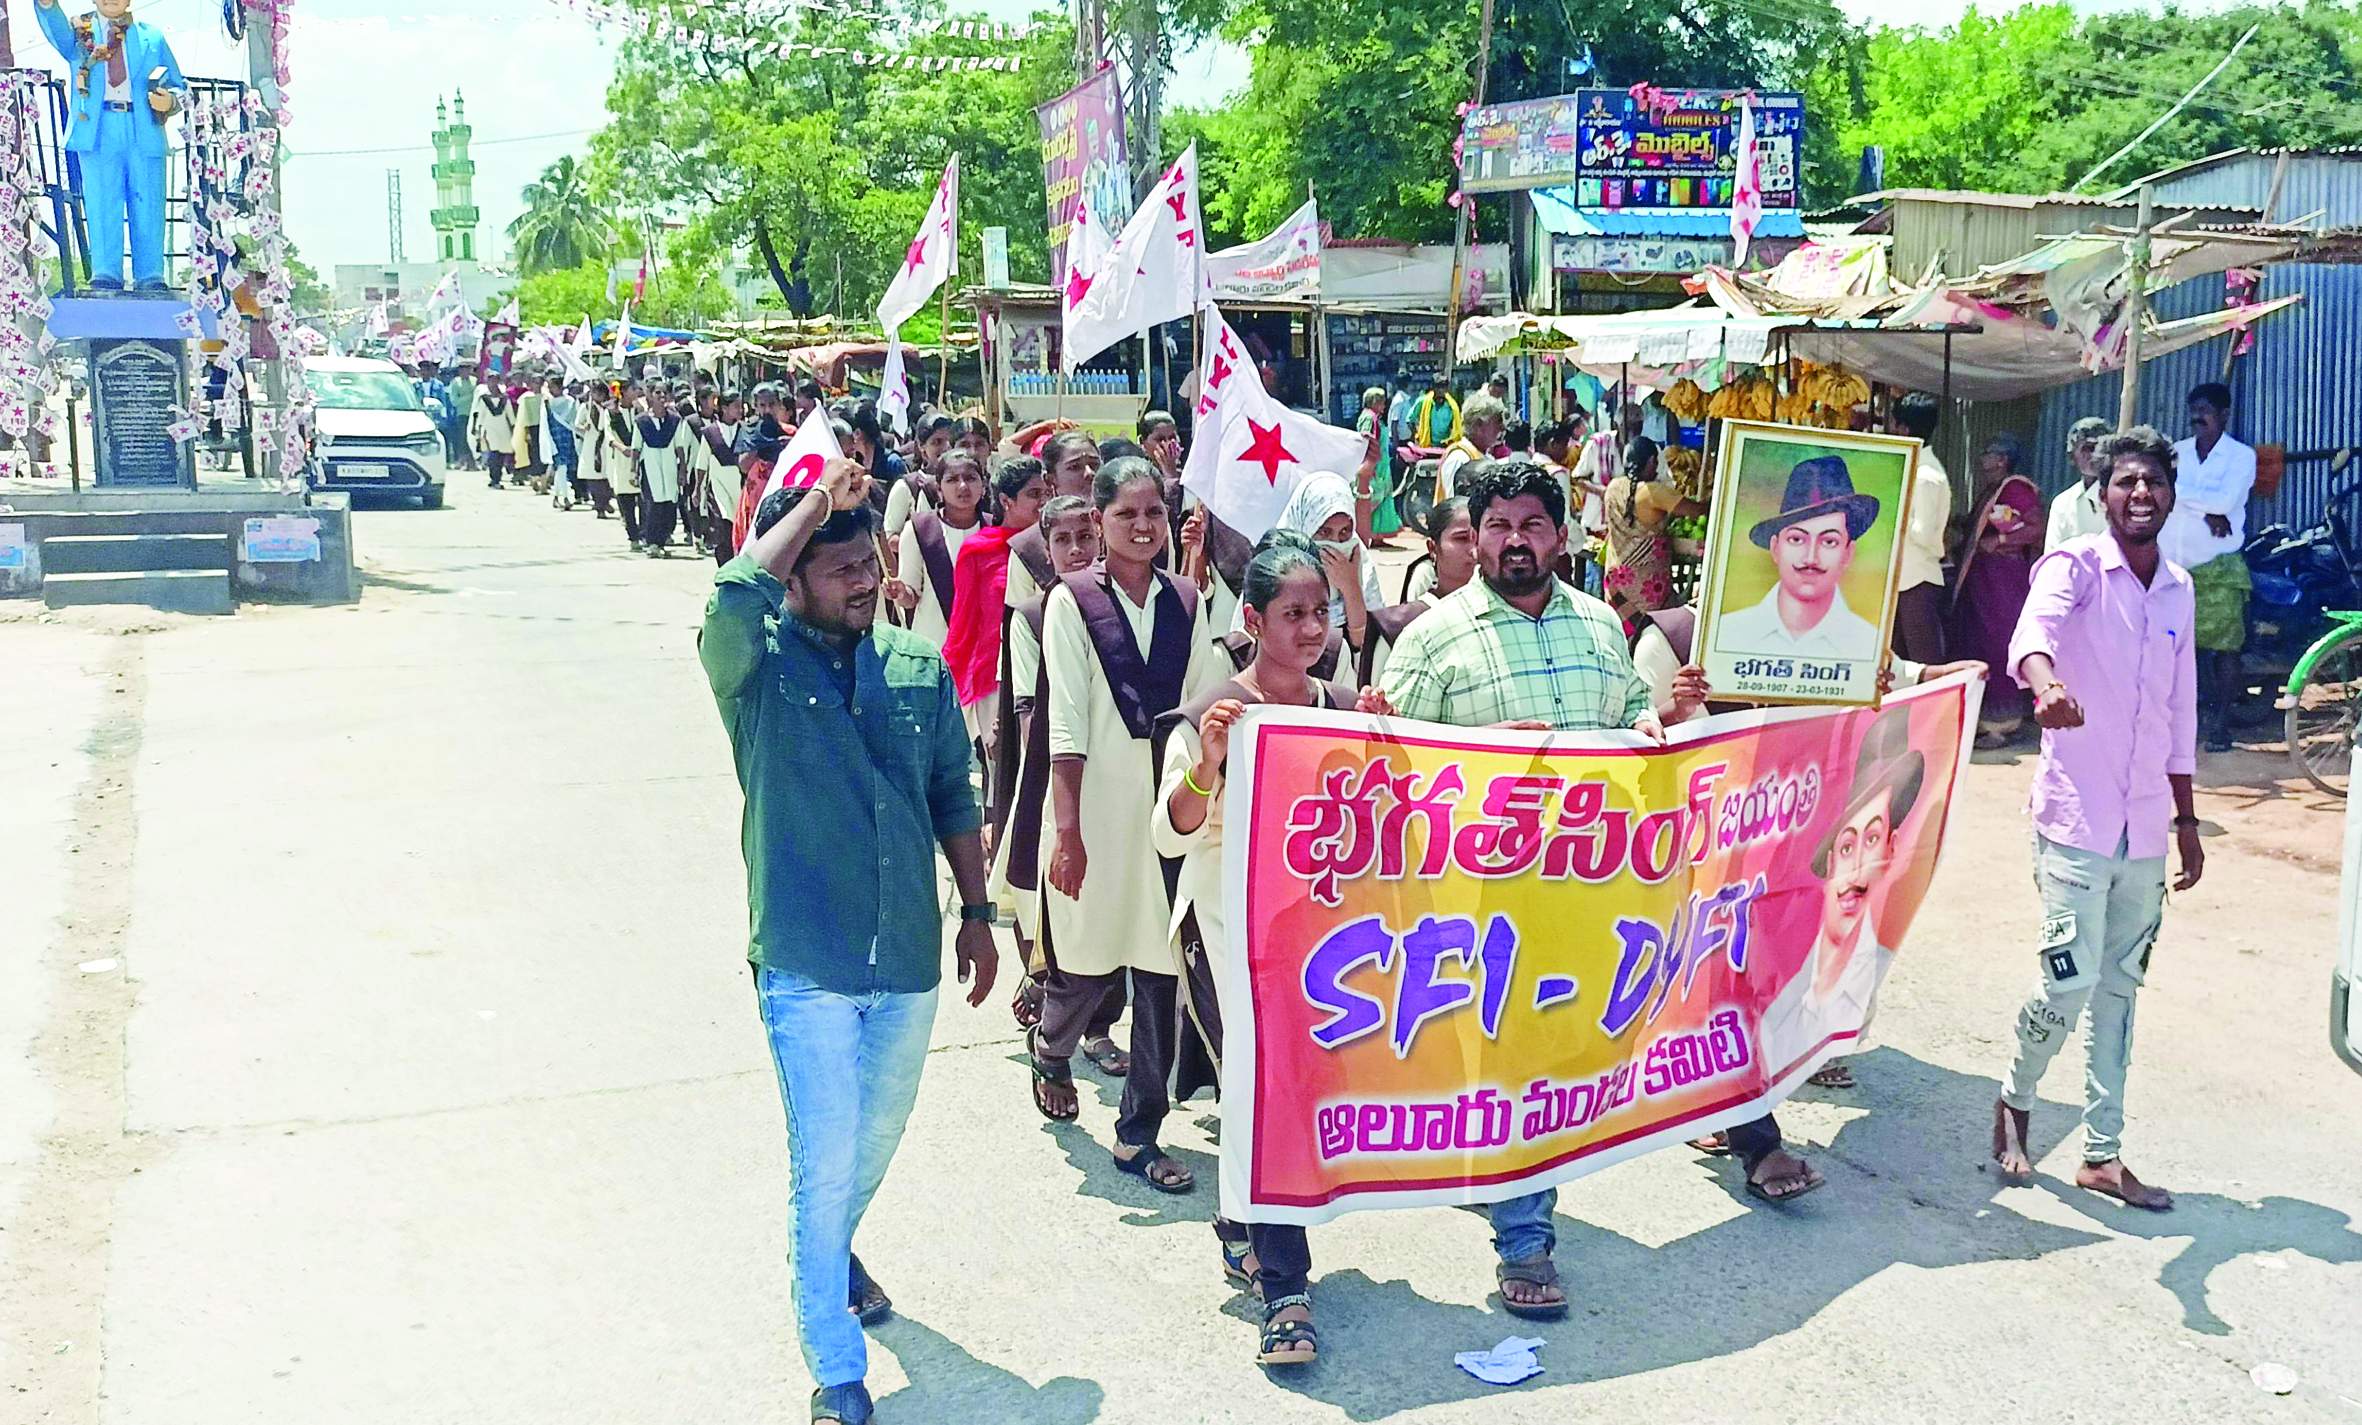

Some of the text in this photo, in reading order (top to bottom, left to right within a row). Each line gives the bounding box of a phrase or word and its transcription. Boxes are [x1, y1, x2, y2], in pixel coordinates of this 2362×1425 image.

[1734, 658, 1851, 681] భగత్ సింగ్
[1737, 681, 1788, 692] 28-09-1907
[1302, 873, 1768, 1057] SFI - DYFI
[1318, 1087, 1513, 1160] ఆలూరు
